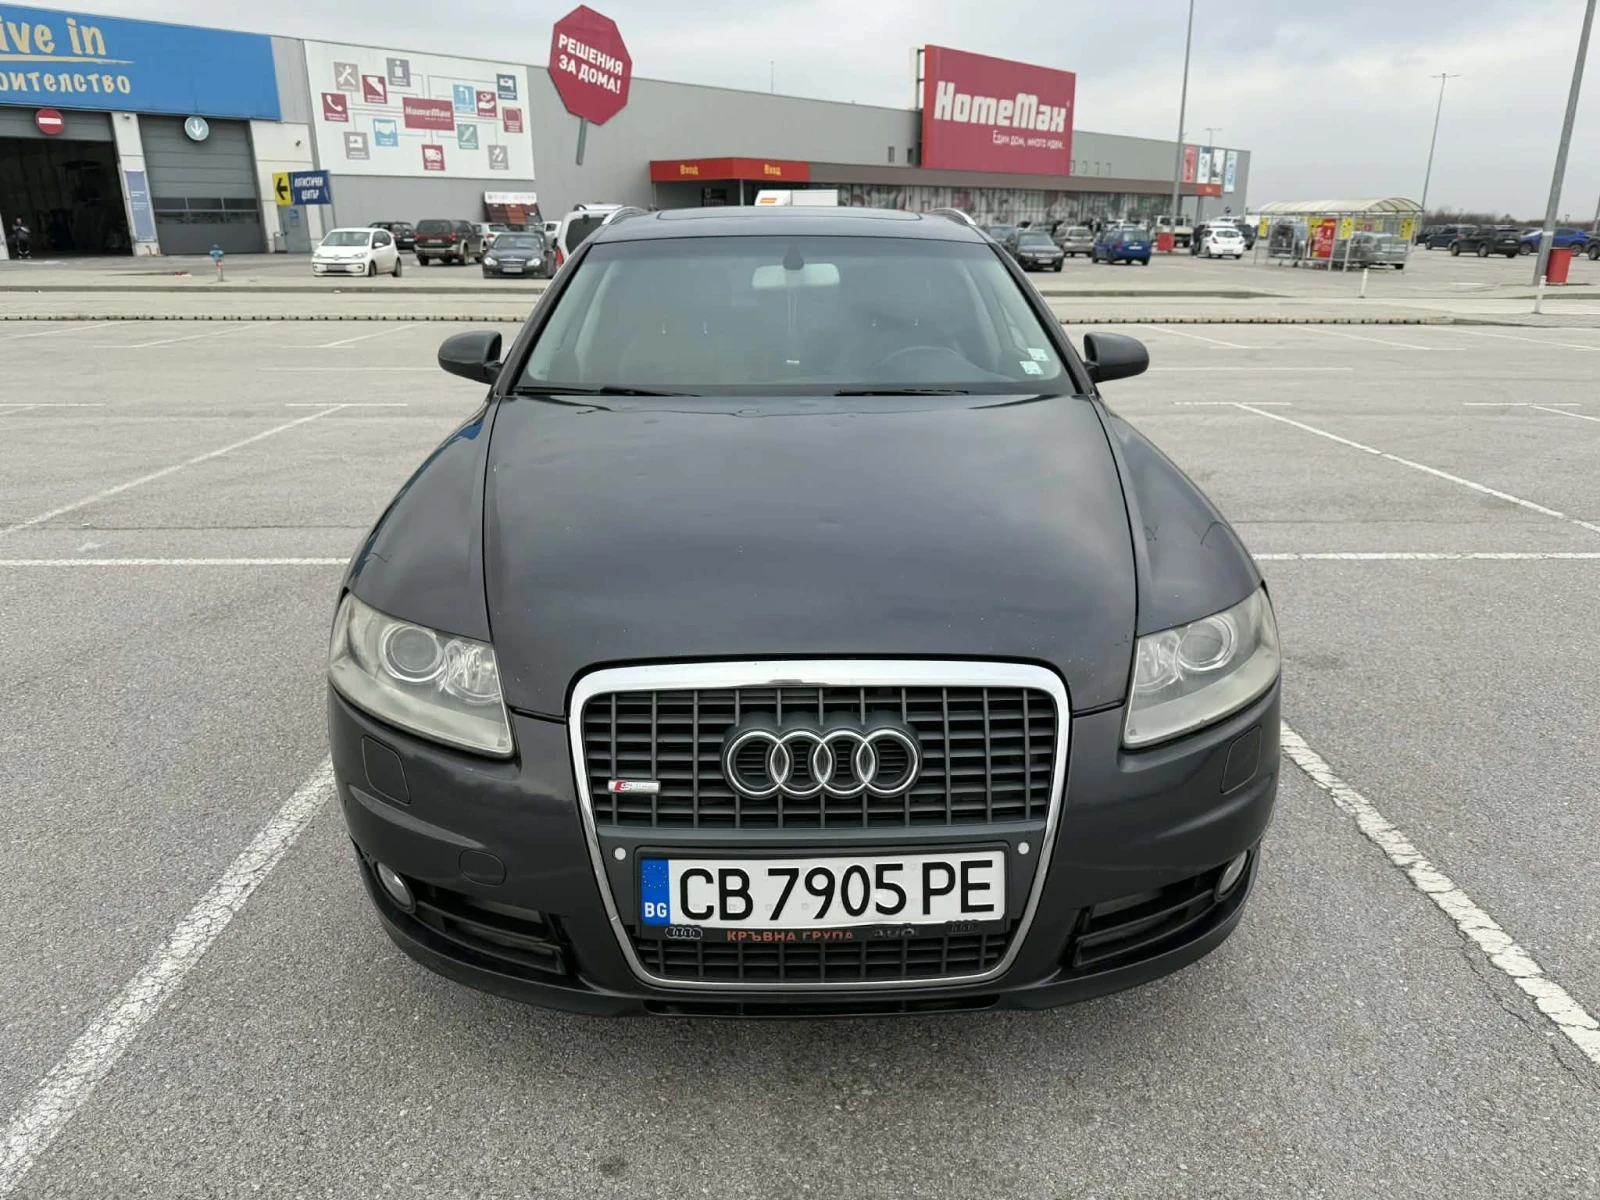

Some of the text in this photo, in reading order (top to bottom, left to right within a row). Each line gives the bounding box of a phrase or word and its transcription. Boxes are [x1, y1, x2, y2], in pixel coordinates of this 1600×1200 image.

[66, 17, 106, 55] in
[558, 33, 624, 75] РЕШЕНИЯ
[558, 54, 622, 94] ЗА ДОМА!
[934, 81, 1067, 132] HomeMax
[680, 164, 699, 176] Вход
[763, 163, 782, 176] Вход
[679, 859, 995, 922] CB 7905 PE
[643, 902, 668, 918] BG
[726, 930, 855, 942] КРЪВНА ГРУПА
